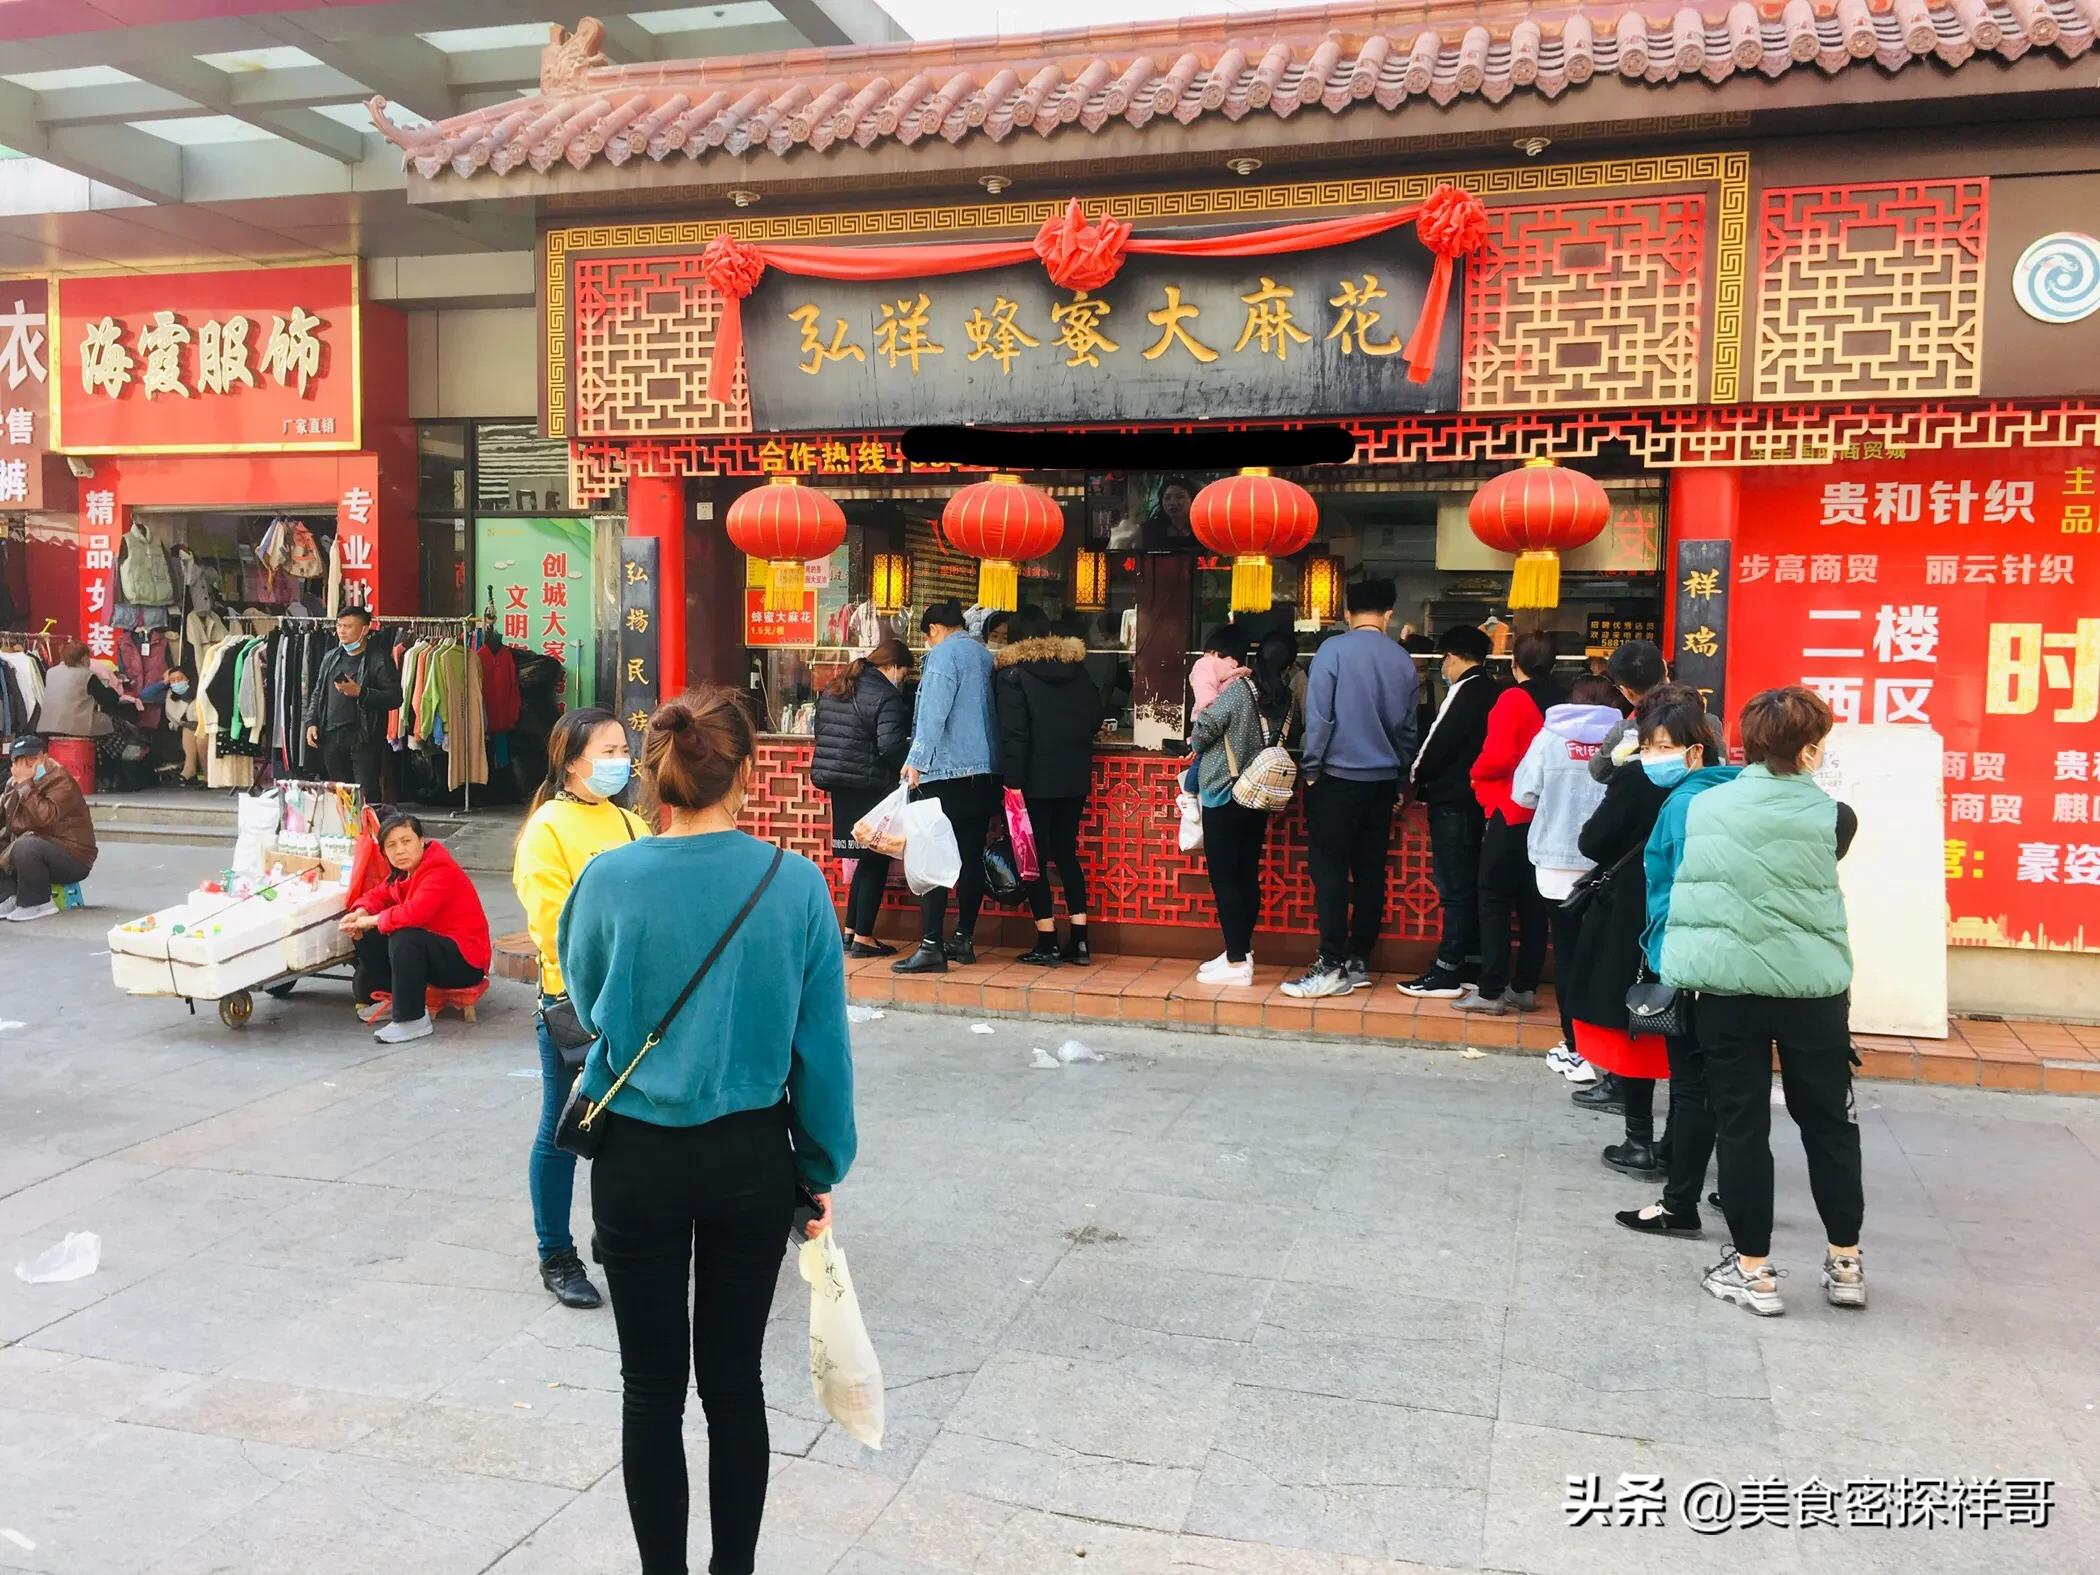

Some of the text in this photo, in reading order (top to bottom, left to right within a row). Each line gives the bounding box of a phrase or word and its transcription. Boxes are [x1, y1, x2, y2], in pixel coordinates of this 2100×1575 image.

[787, 273, 1402, 376] 弘祥蜂蜜大麻花
[79, 306, 321, 401] 海霞服饰
[0, 407, 34, 445] 售
[282, 416, 336, 434] 厂家直销
[1820, 480, 2036, 526] 贵和针织
[84, 489, 116, 658] 精品女装
[1738, 553, 2075, 585] 步高商贸 丽云针织
[751, 611, 813, 624] 蜂蜜大麻花
[1682, 567, 1723, 714] 祥瑞
[1802, 604, 1939, 663] 二楼
[1801, 676, 1935, 725] 西区
[1942, 793, 2100, 825] 商贸 麒
